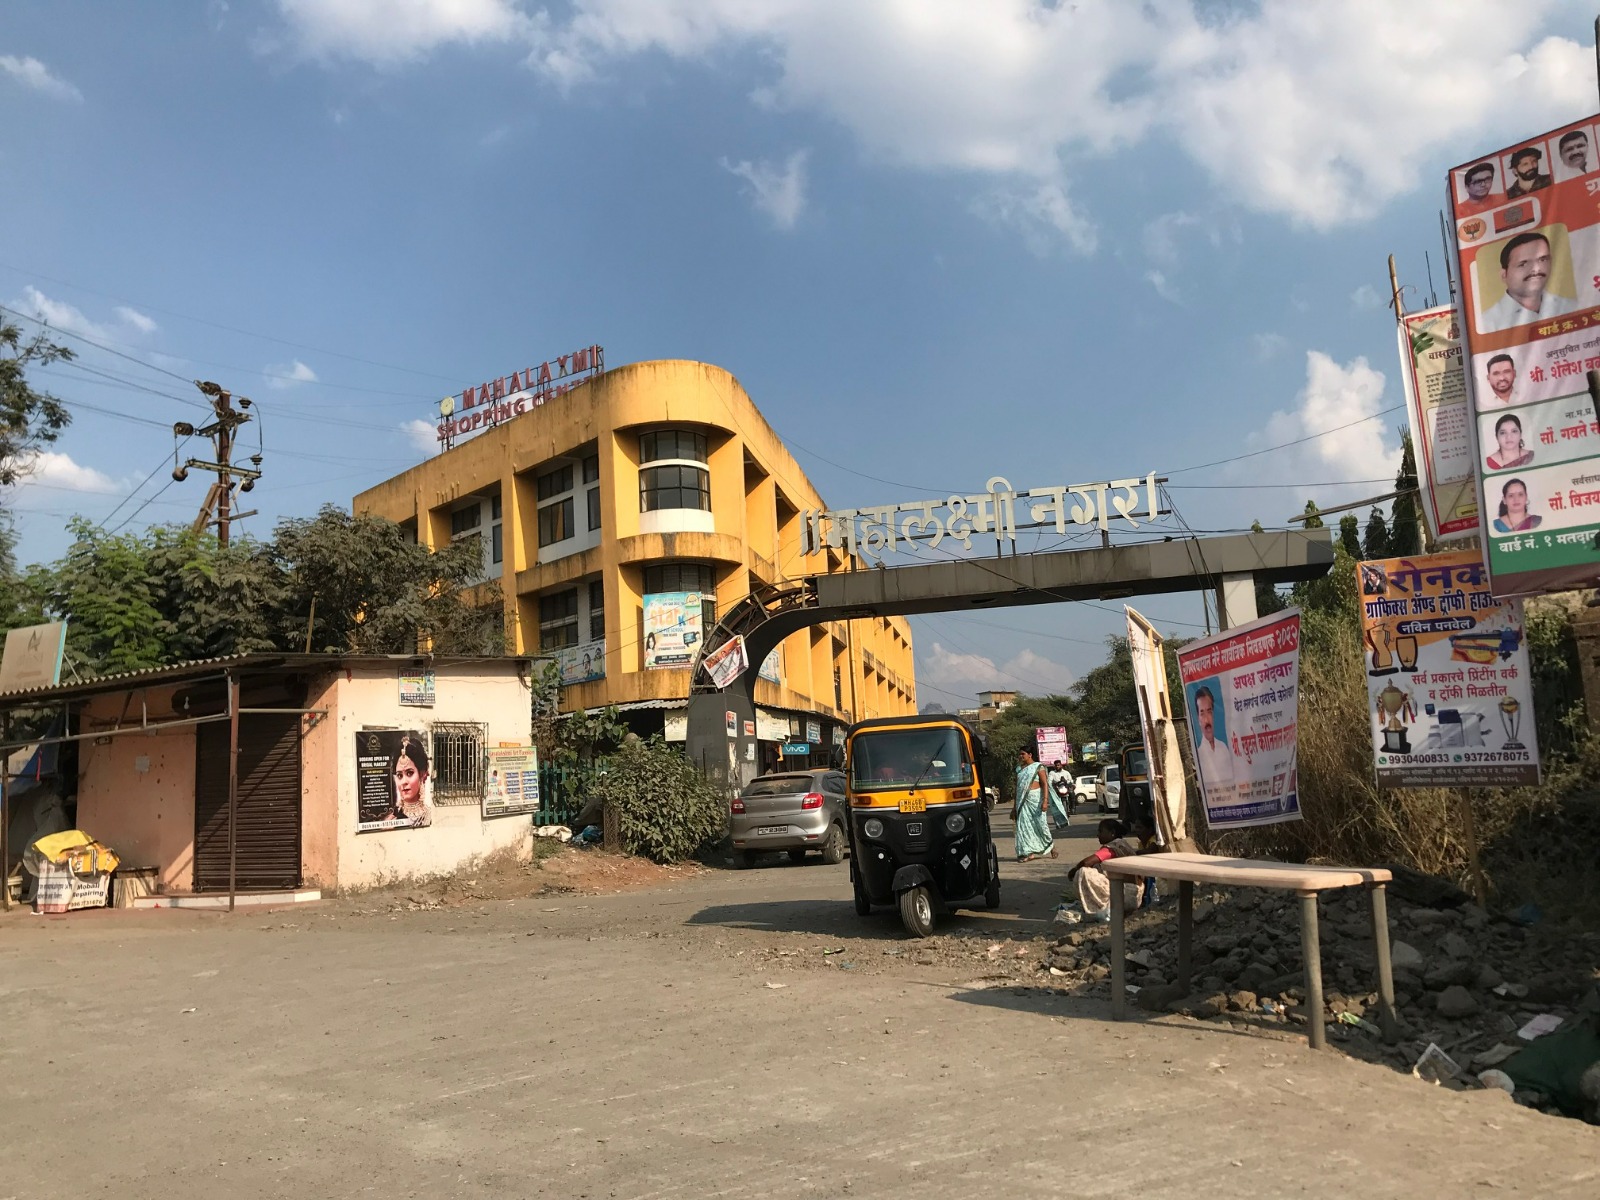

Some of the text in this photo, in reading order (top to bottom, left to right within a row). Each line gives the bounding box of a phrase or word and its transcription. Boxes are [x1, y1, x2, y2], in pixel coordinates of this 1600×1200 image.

[463, 345, 598, 410] MAHALAXMI
[437, 398, 525, 441] SHOPPING
[1498, 536, 1521, 553] वार्ड
[1401, 618, 1471, 634] नविन पनवेल
[1233, 661, 1294, 689] अपक्ष उमेदवार
[1412, 671, 1428, 685] सर्व
[1431, 669, 1464, 685] प्रकारचे
[1500, 665, 1518, 679] वर्क
[1439, 684, 1464, 702] ट्रॉफी
[1467, 682, 1508, 699] मिळतील
[1389, 752, 1530, 764] 9930400833 9372678075
